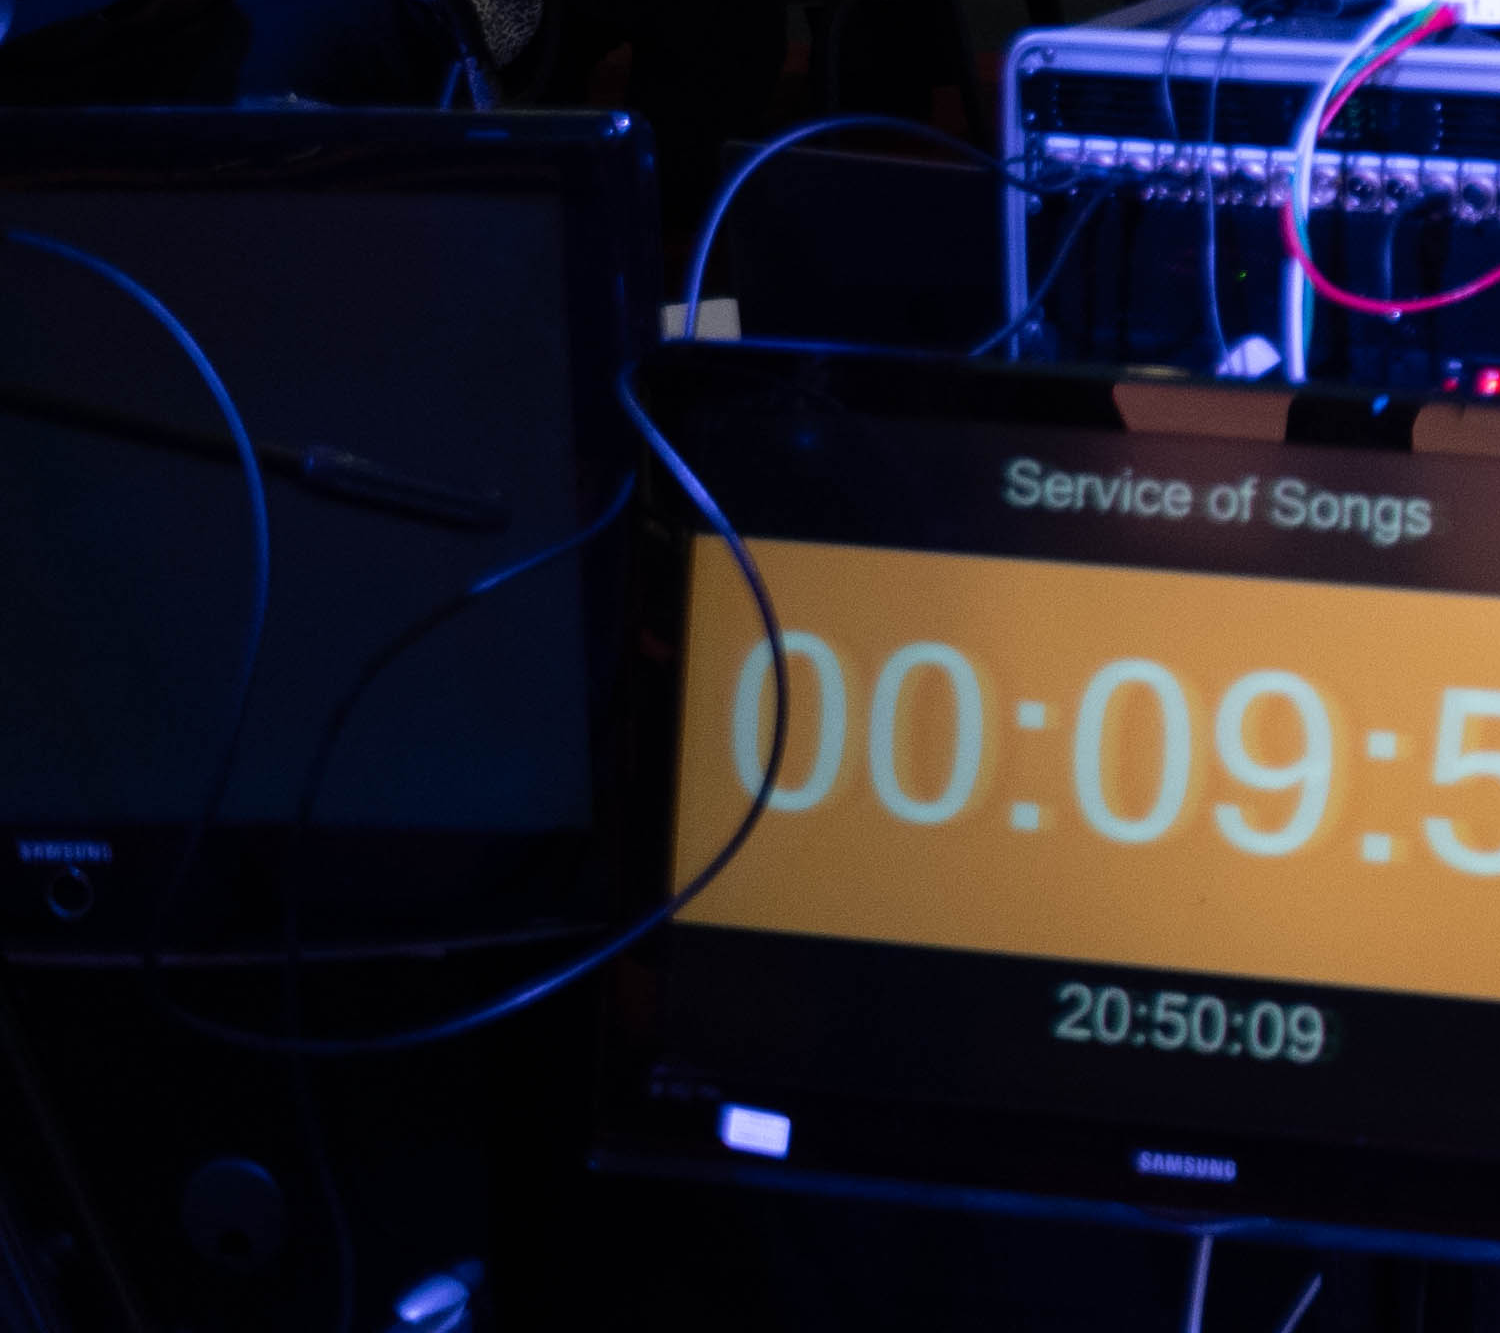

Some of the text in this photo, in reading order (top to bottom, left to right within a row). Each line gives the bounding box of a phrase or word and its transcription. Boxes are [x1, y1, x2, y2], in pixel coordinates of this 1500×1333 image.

[1006, 457, 1432, 546] Service of Songs
[1055, 983, 1325, 1063] 20:50:09
[1137, 1151, 1238, 1181] SAMSUNG
